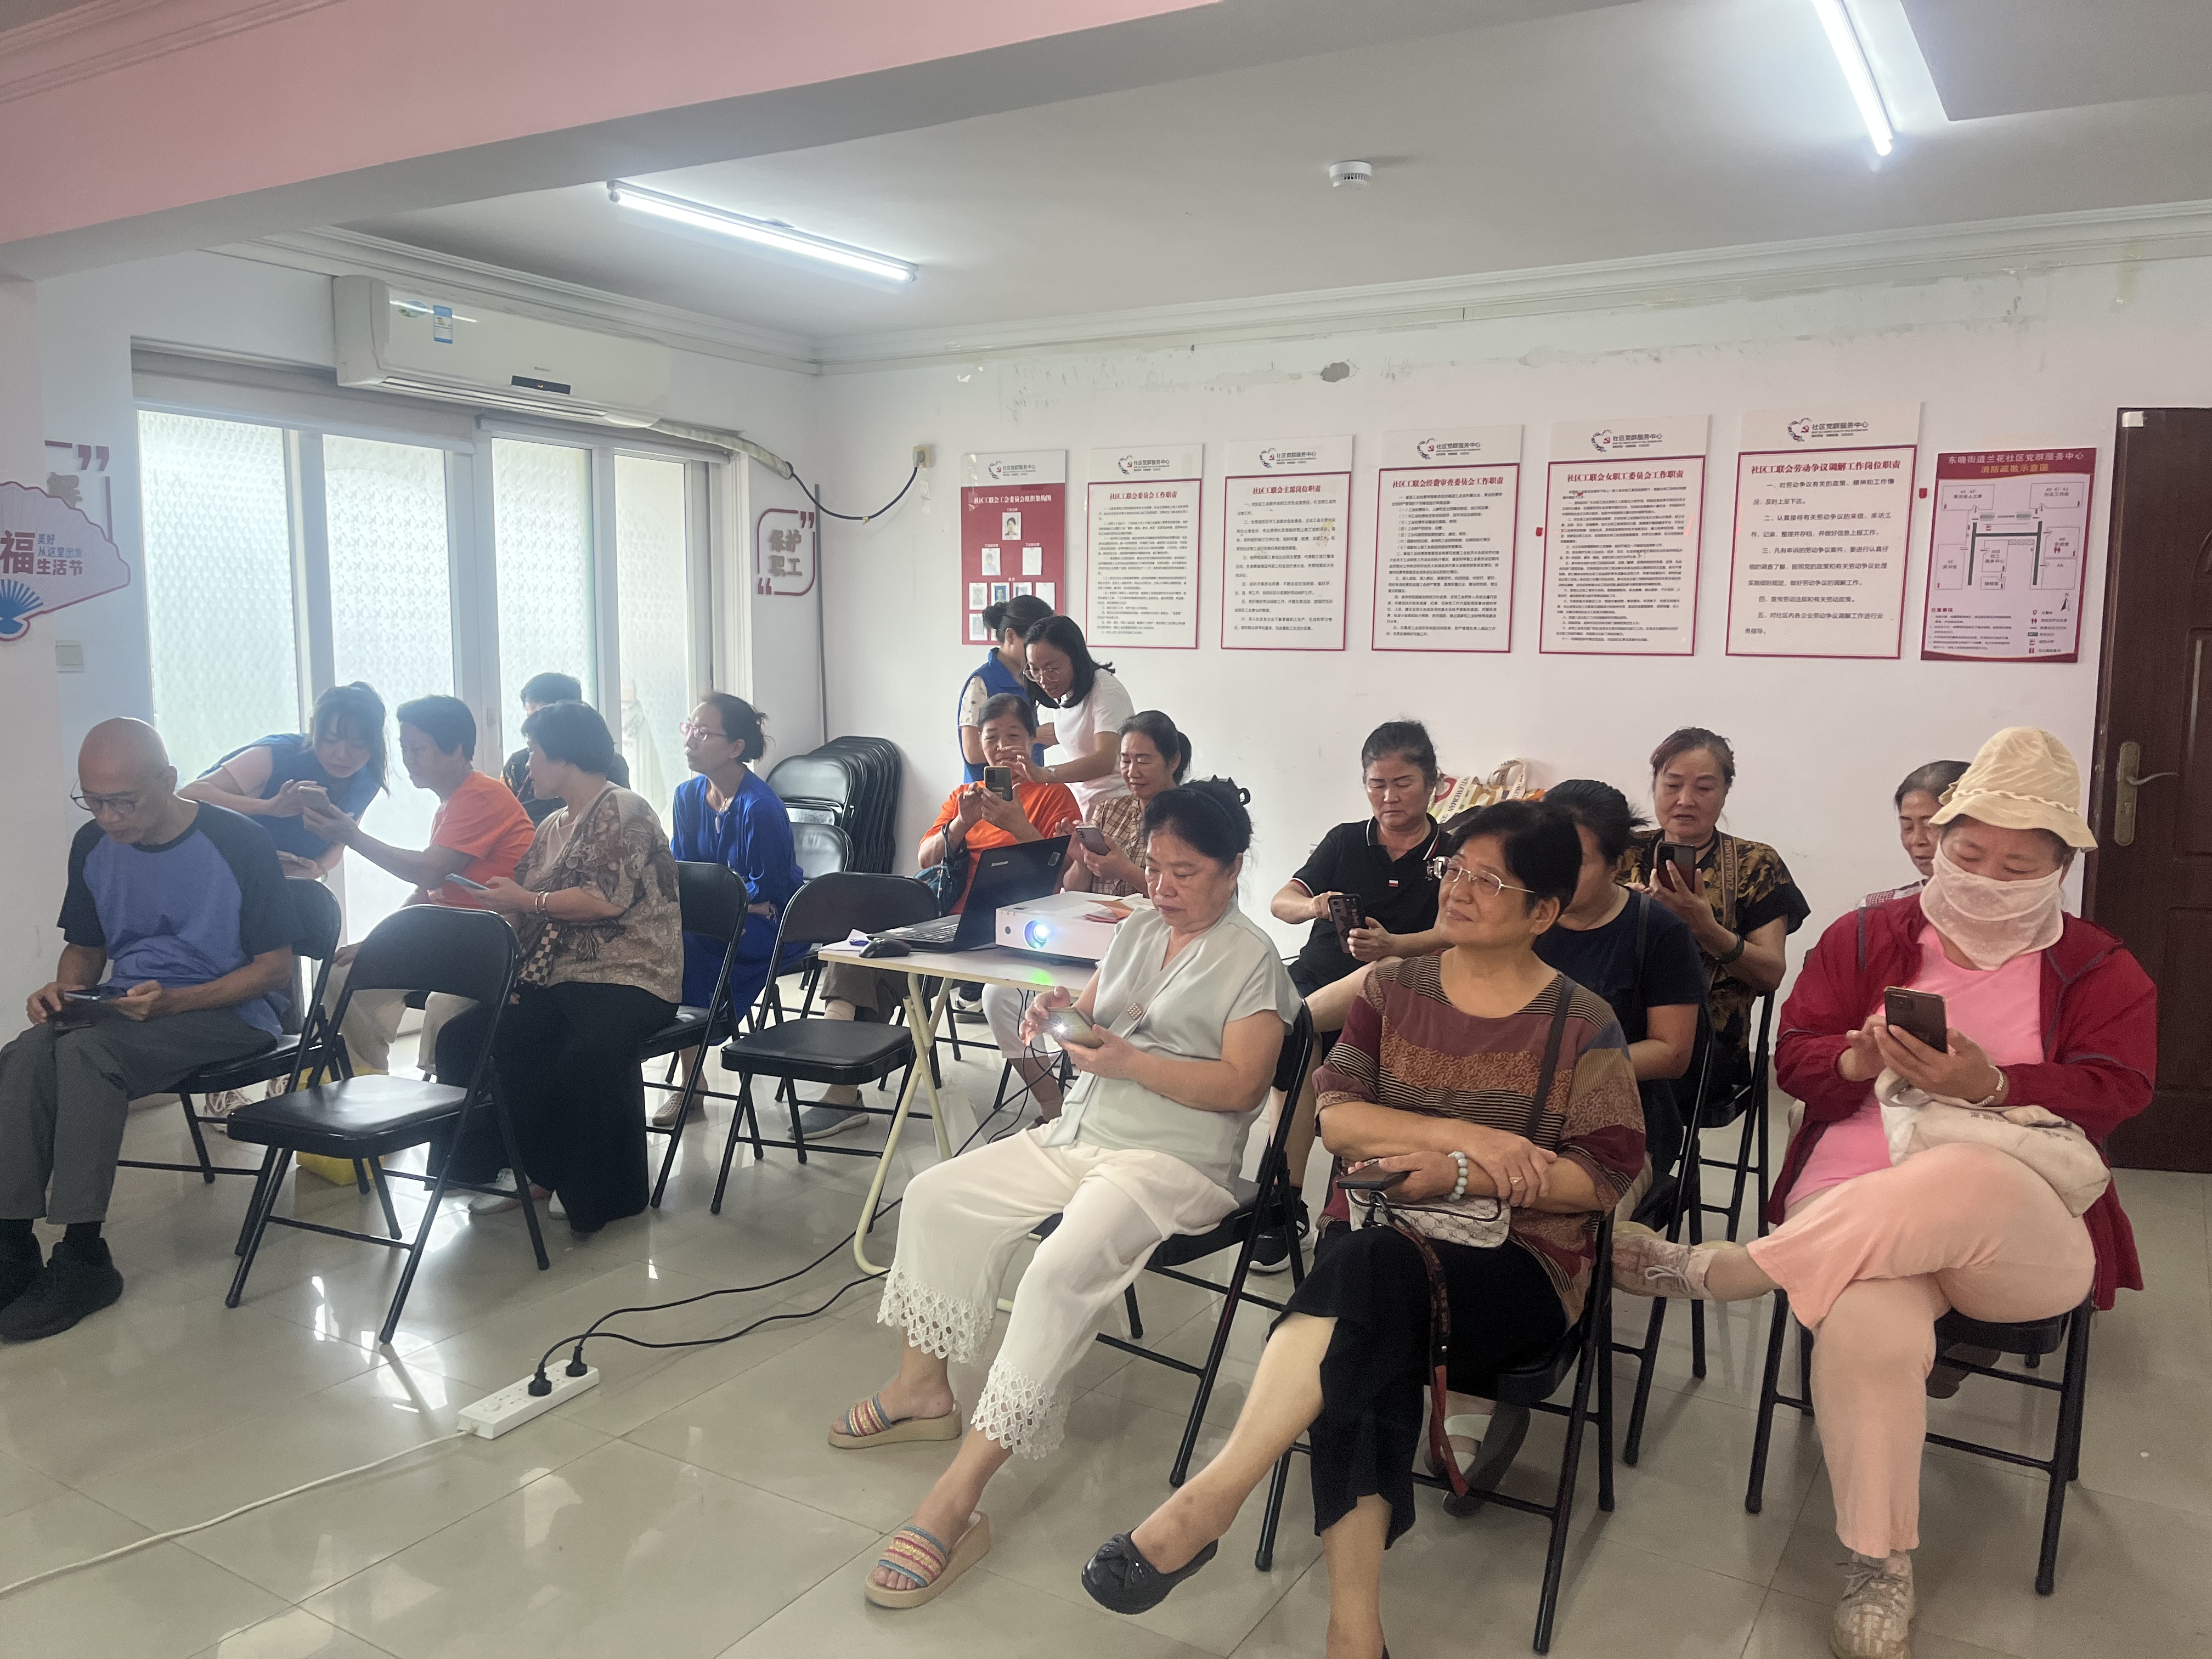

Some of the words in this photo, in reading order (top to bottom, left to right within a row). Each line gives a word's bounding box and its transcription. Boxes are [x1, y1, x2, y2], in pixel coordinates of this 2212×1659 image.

[1948, 452, 2085, 465] 东晓街道兰花社区党群服务中心
[1751, 460, 1901, 475] 社区工联会劳动争议调解工作岗位职责
[1981, 464, 2049, 474] 消防疏散示意图
[1392, 477, 1504, 488] 社区工联会经费审查委员会工作职责
[1567, 470, 1684, 483] 社区工联会女职工委员会工作职责
[1110, 491, 1177, 500] 社区工联会委员会工作职责
[1253, 485, 1321, 495] 社区工联会主席岗位职责
[37, 533, 55, 545] 美好
[0, 529, 36, 575] 福
[37, 546, 83, 558] 从这里出发
[36, 558, 83, 576] 生活节
